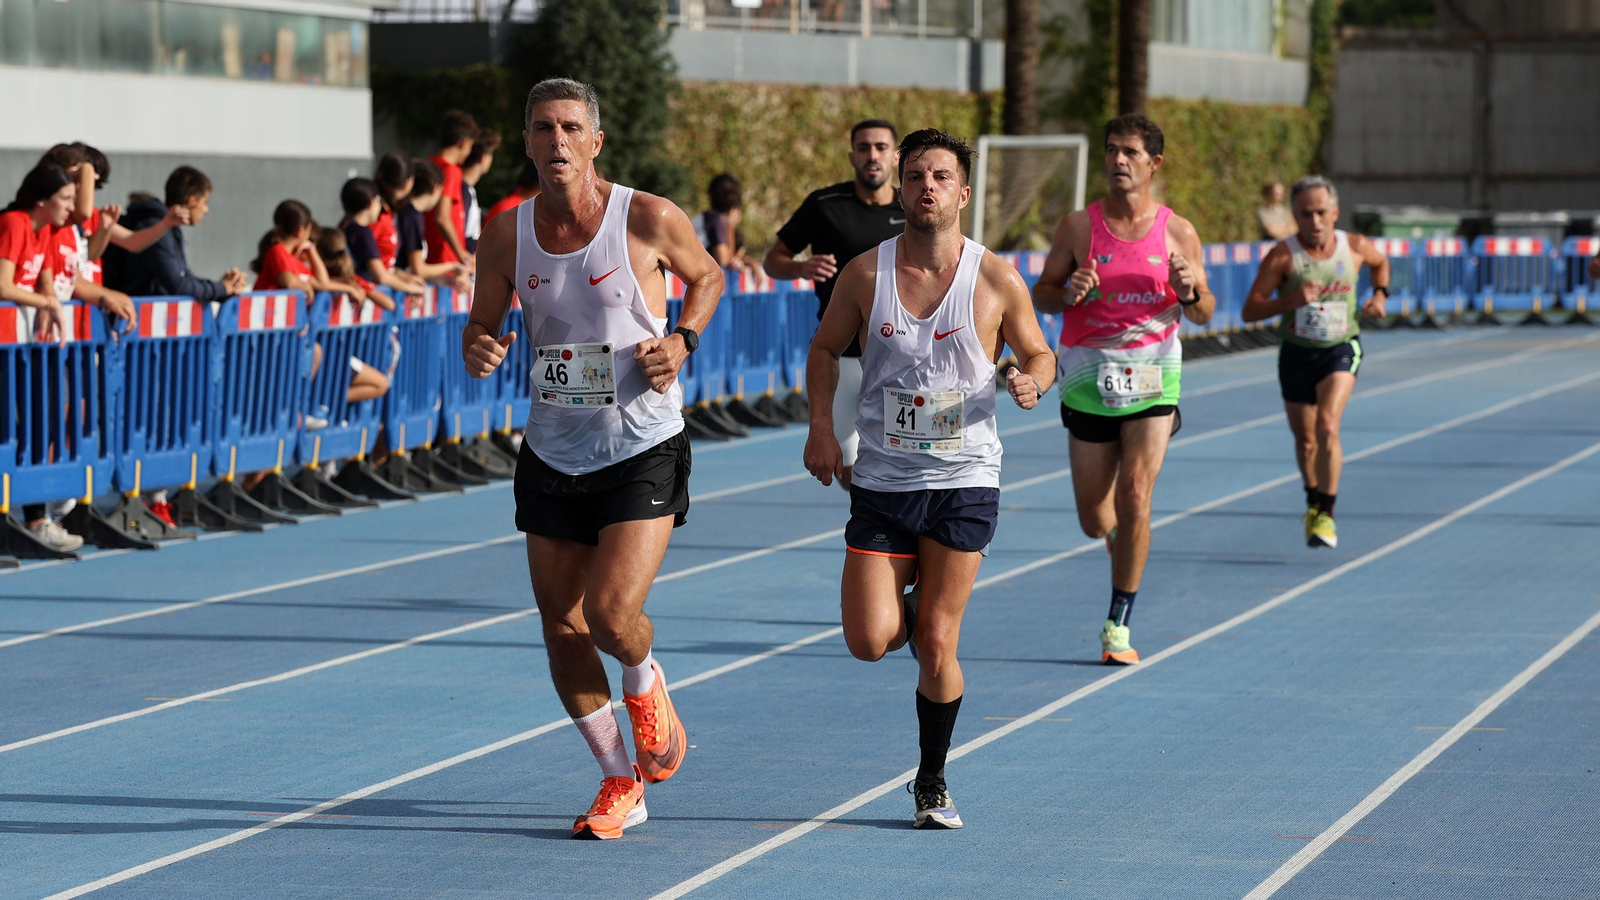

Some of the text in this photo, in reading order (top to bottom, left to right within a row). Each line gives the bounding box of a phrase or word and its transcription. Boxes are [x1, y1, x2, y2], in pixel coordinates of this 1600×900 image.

[544, 363, 569, 386] 46
[1104, 375, 1132, 392] 614
[896, 406, 916, 430] 41
